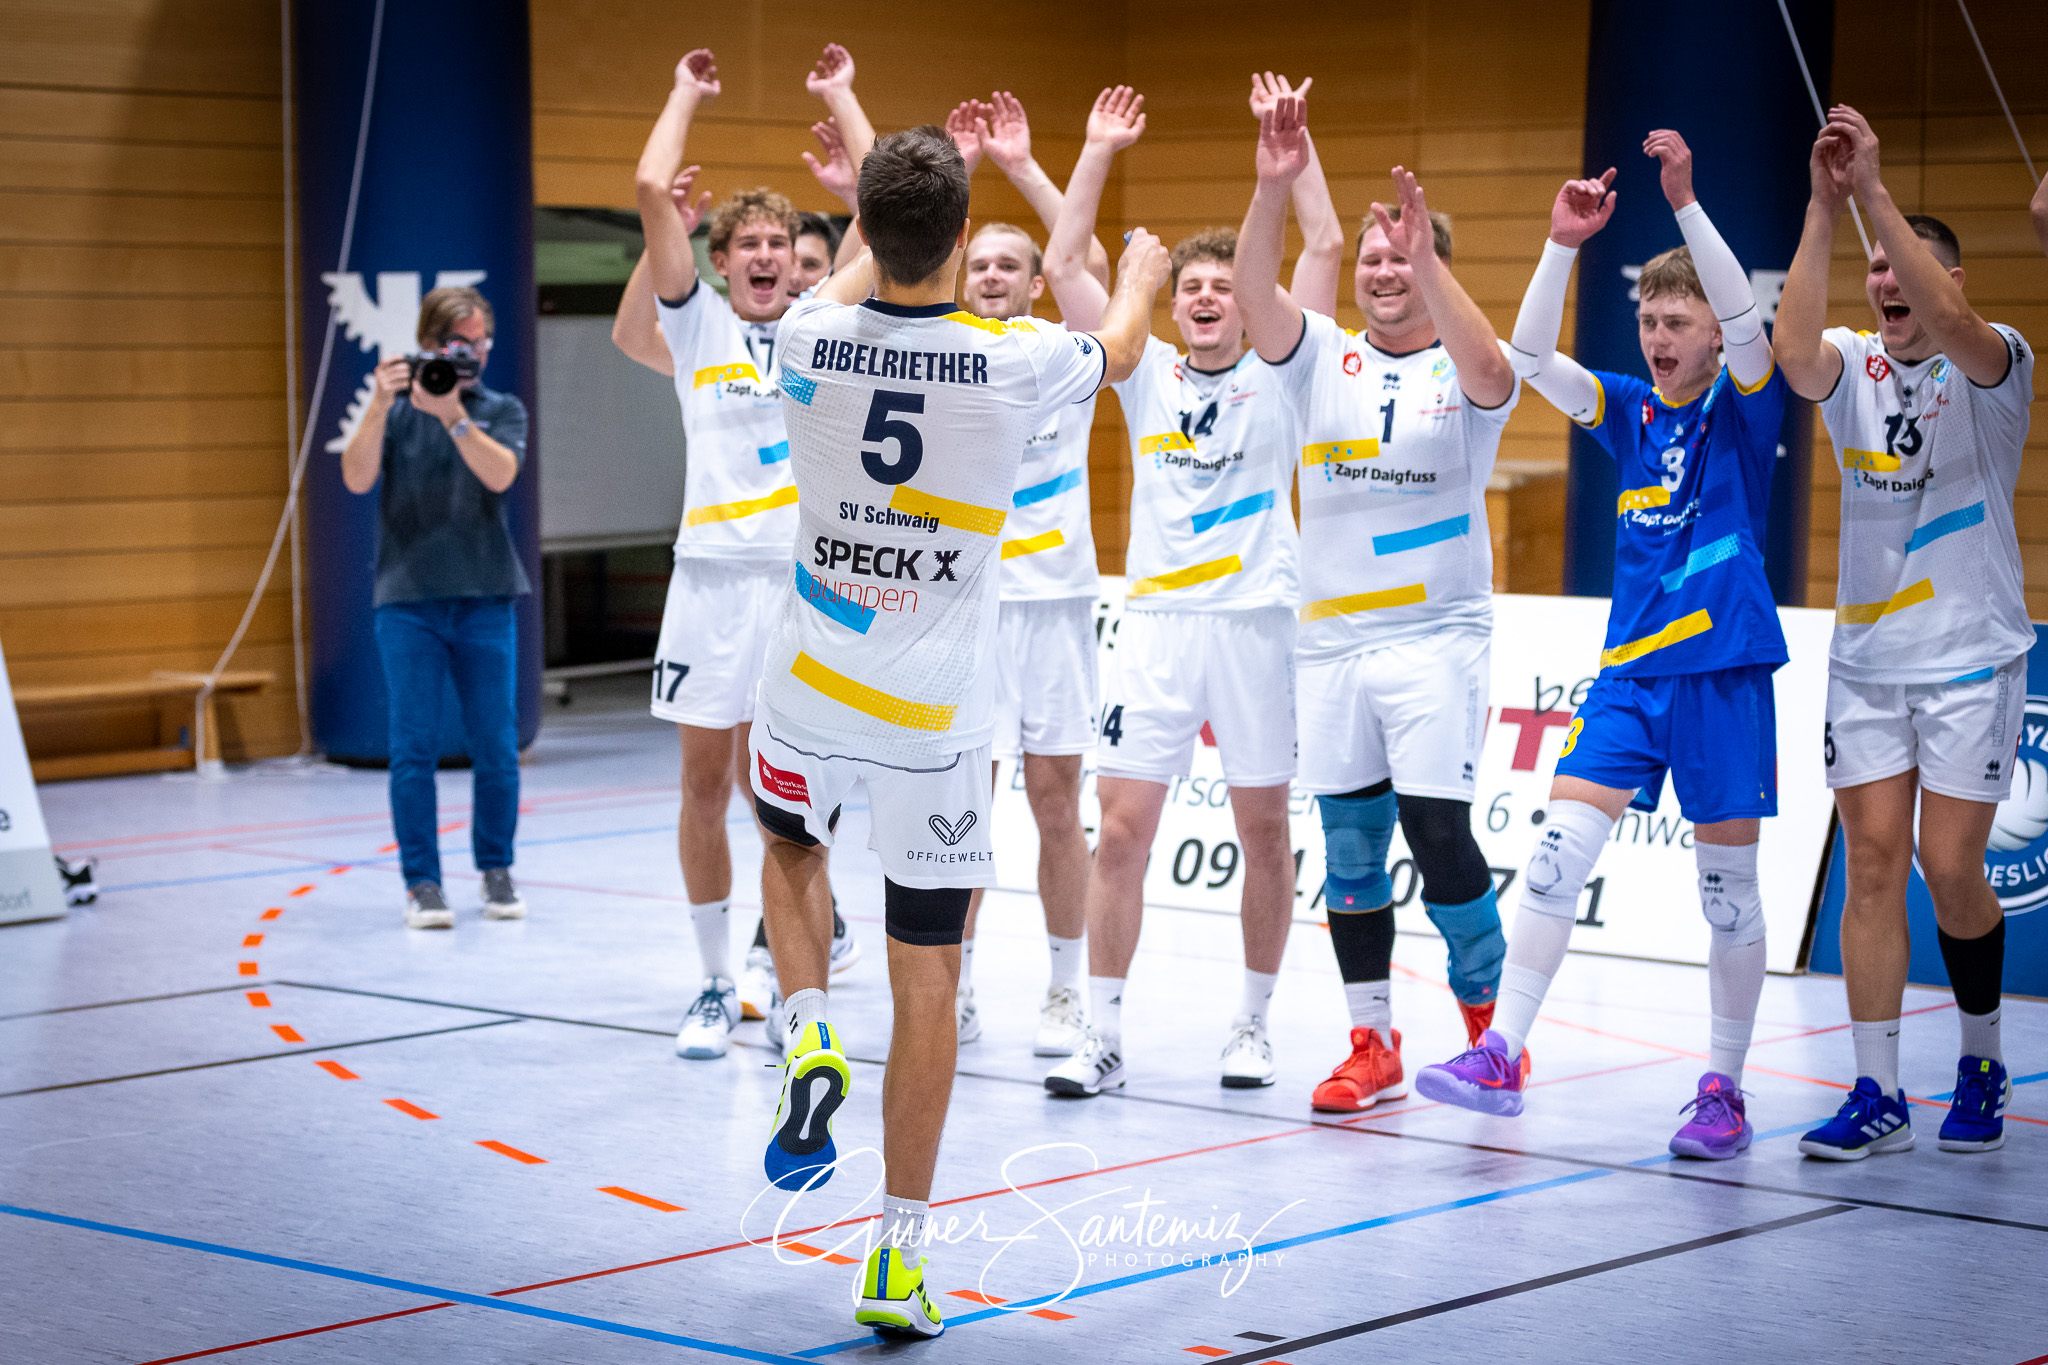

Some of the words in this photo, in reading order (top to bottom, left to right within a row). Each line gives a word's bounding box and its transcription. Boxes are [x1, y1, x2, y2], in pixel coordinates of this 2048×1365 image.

[811, 338, 988, 384] BIBELRIETHER
[860, 388, 926, 486] 5
[1380, 398, 1396, 443] 1
[1335, 463, 1368, 480] Zapf
[1371, 468, 1437, 485] Daigfuss
[1661, 447, 1686, 493] 3
[1862, 470, 1888, 490] Zapf
[839, 501, 860, 522] SV
[864, 505, 940, 534] Schwaig
[814, 536, 924, 582] SPECK
[808, 574, 919, 615] pumpen
[654, 659, 690, 703] 17
[1101, 703, 1125, 747] 4
[1487, 791, 1513, 833] 6
[906, 850, 994, 864] OFFICEWELT
